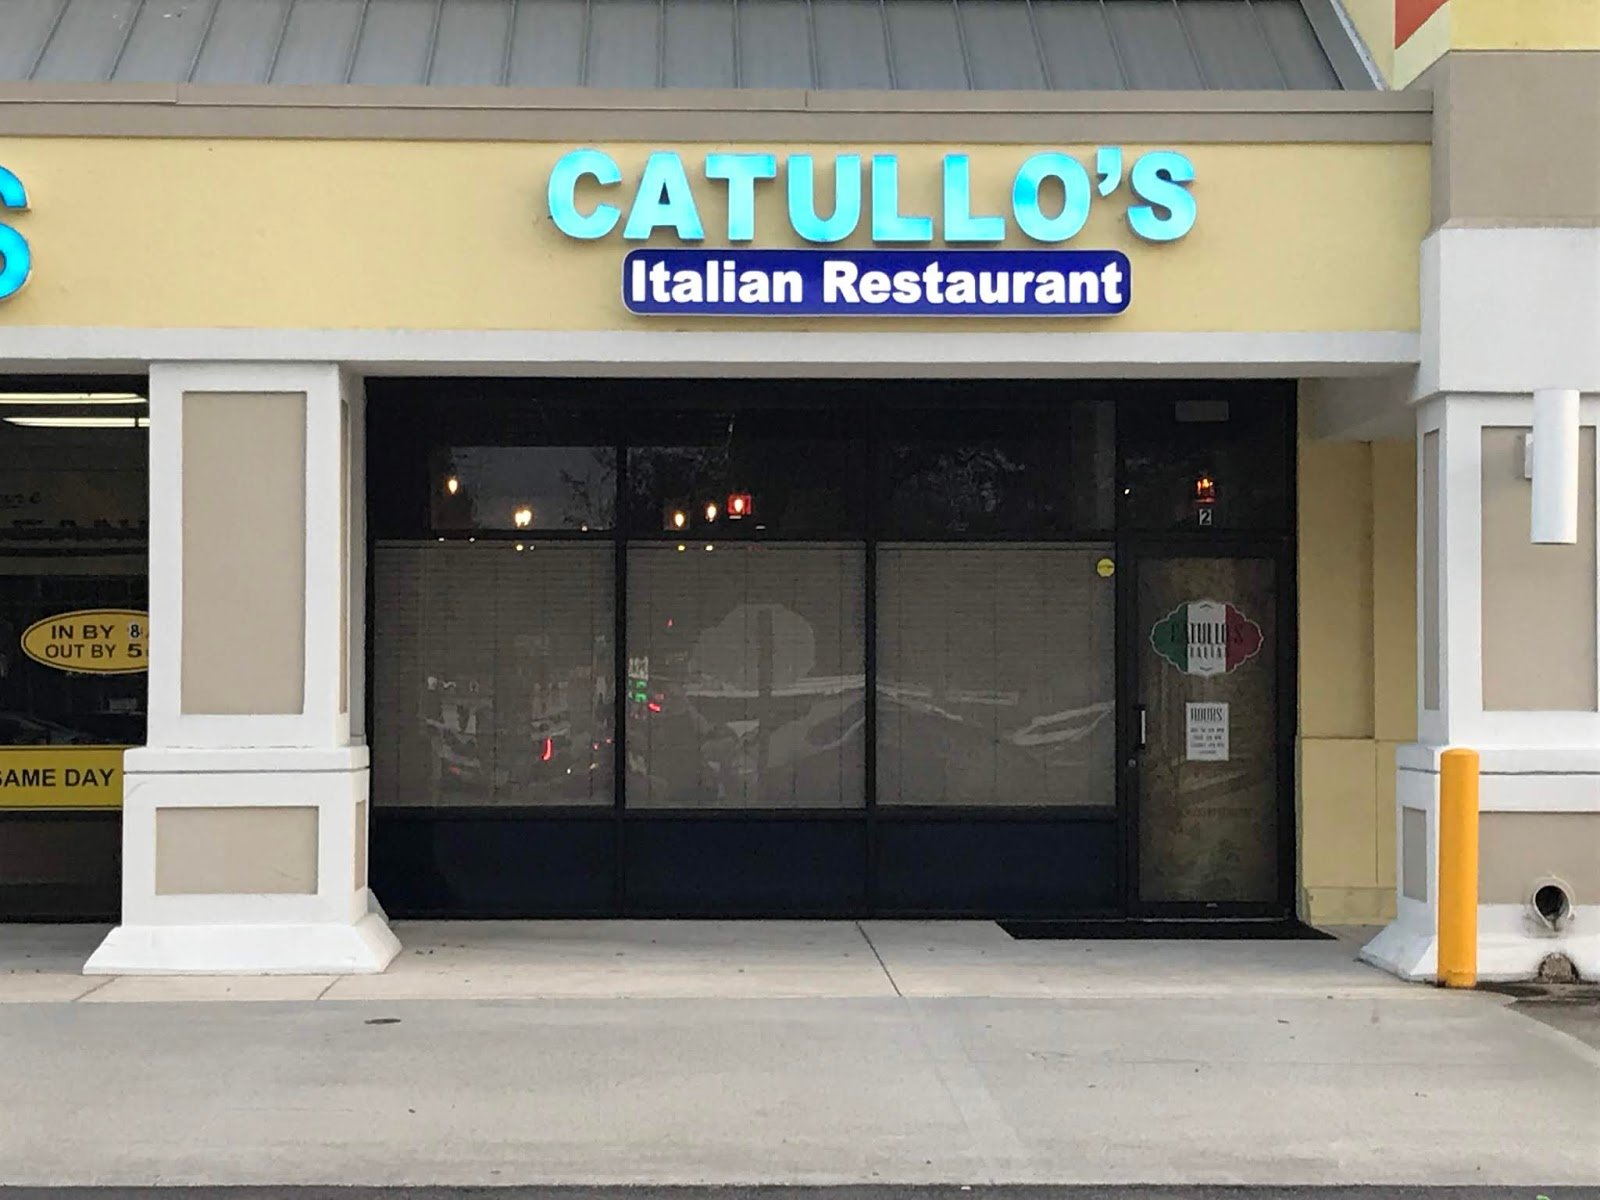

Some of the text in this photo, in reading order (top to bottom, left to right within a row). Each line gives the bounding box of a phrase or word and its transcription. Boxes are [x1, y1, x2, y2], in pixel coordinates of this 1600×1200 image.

[547, 146, 1197, 243] CATULLO'S
[630, 259, 1124, 306] Italian Restaurant
[1201, 509, 1211, 524] 2
[51, 625, 74, 640] IN
[83, 625, 114, 640] BY
[45, 644, 84, 659] OUT
[91, 644, 116, 659] BY
[0, 769, 114, 787] AME DAY
